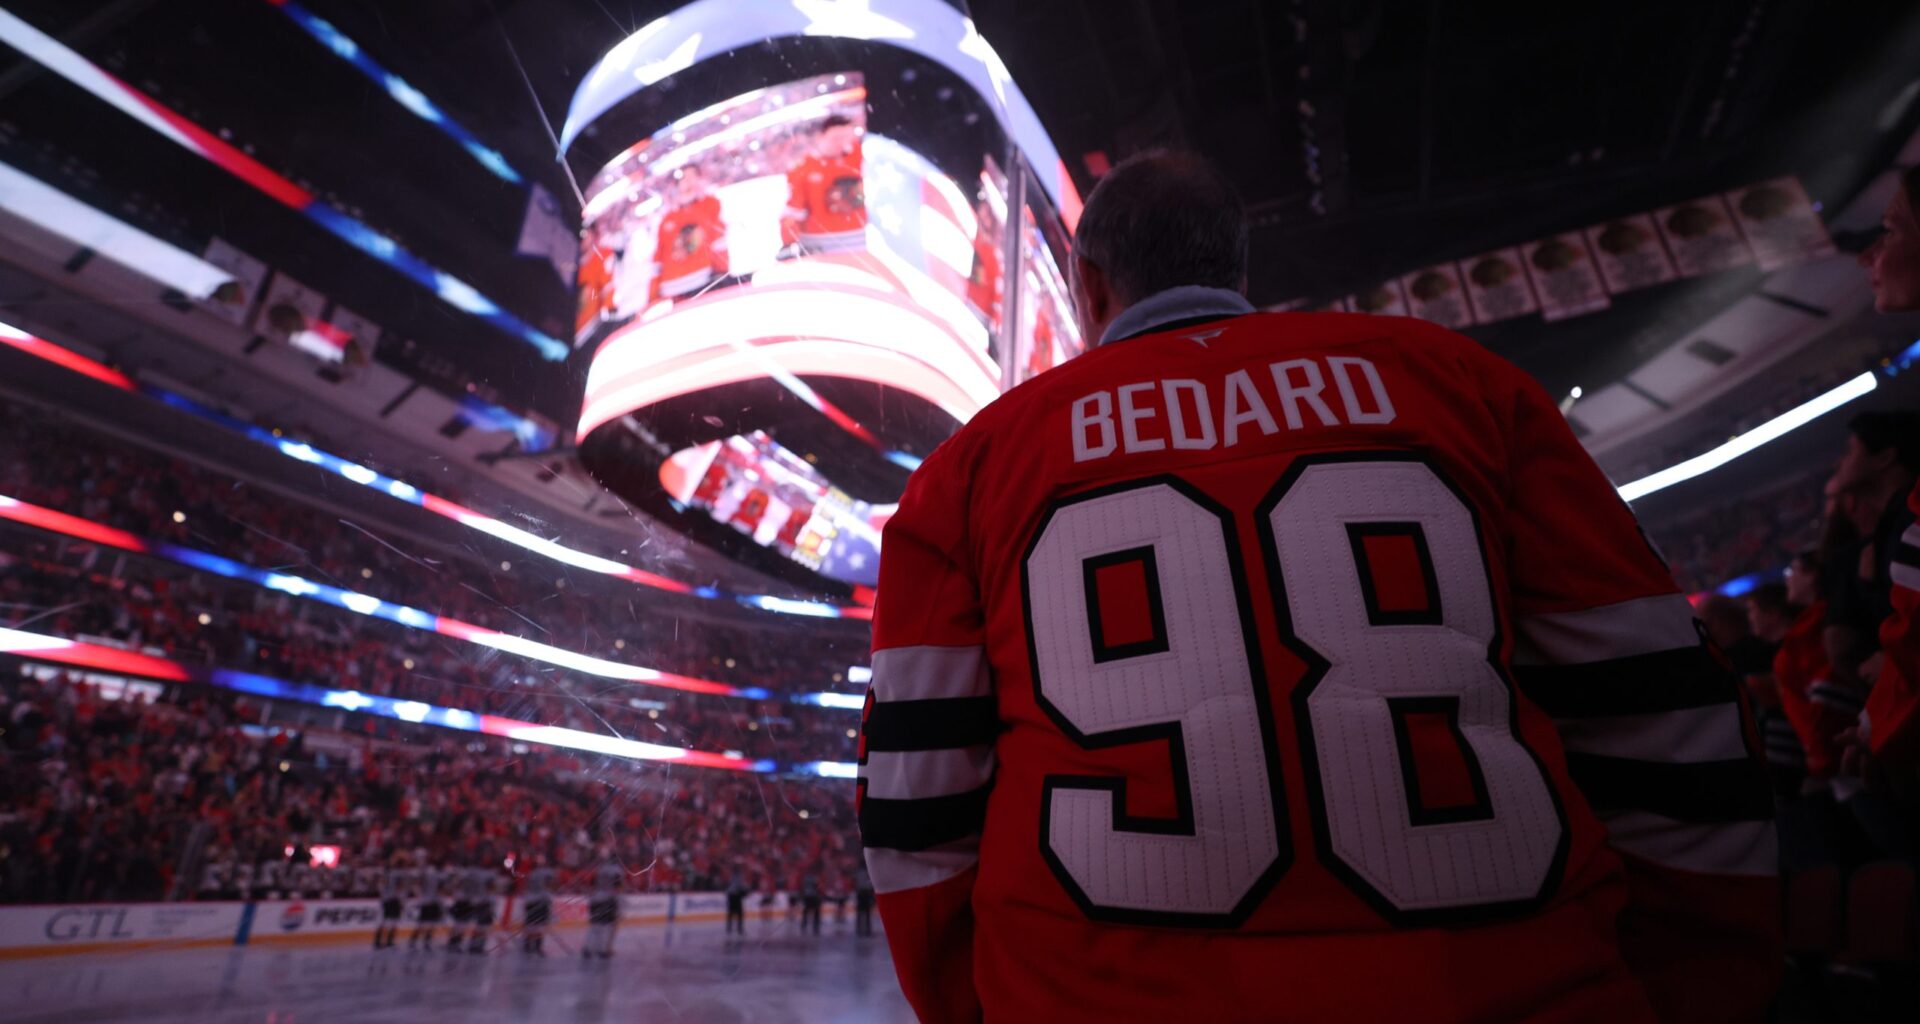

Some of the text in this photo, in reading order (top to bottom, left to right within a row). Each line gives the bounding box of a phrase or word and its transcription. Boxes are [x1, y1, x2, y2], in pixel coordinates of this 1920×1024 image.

[1071, 356, 1397, 463] BEDARD
[1020, 452, 1570, 928] 98
[44, 908, 133, 940] GTL
